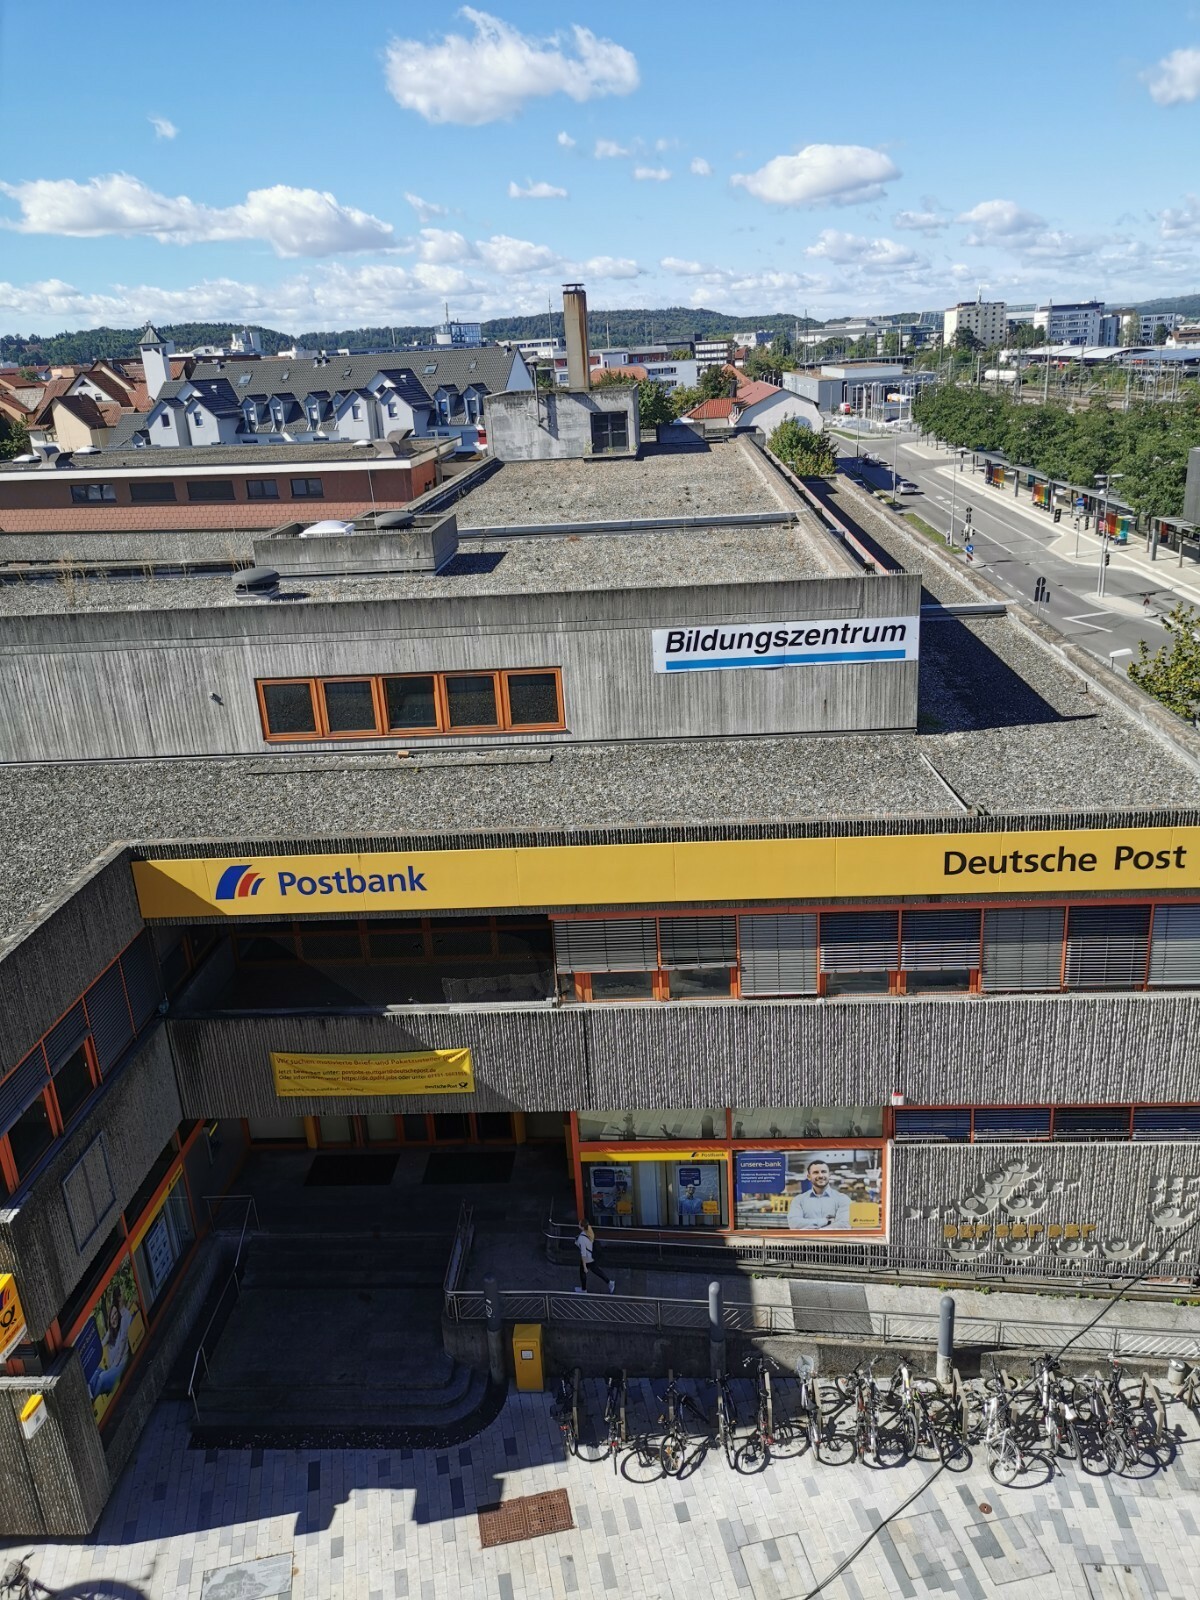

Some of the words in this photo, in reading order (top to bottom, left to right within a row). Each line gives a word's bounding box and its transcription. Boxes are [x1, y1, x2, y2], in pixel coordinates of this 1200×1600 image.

[665, 622, 907, 655] Bildungszentrum
[944, 847, 1097, 876] Deutsche
[1115, 845, 1188, 870] Post
[278, 866, 427, 895] Postbank
